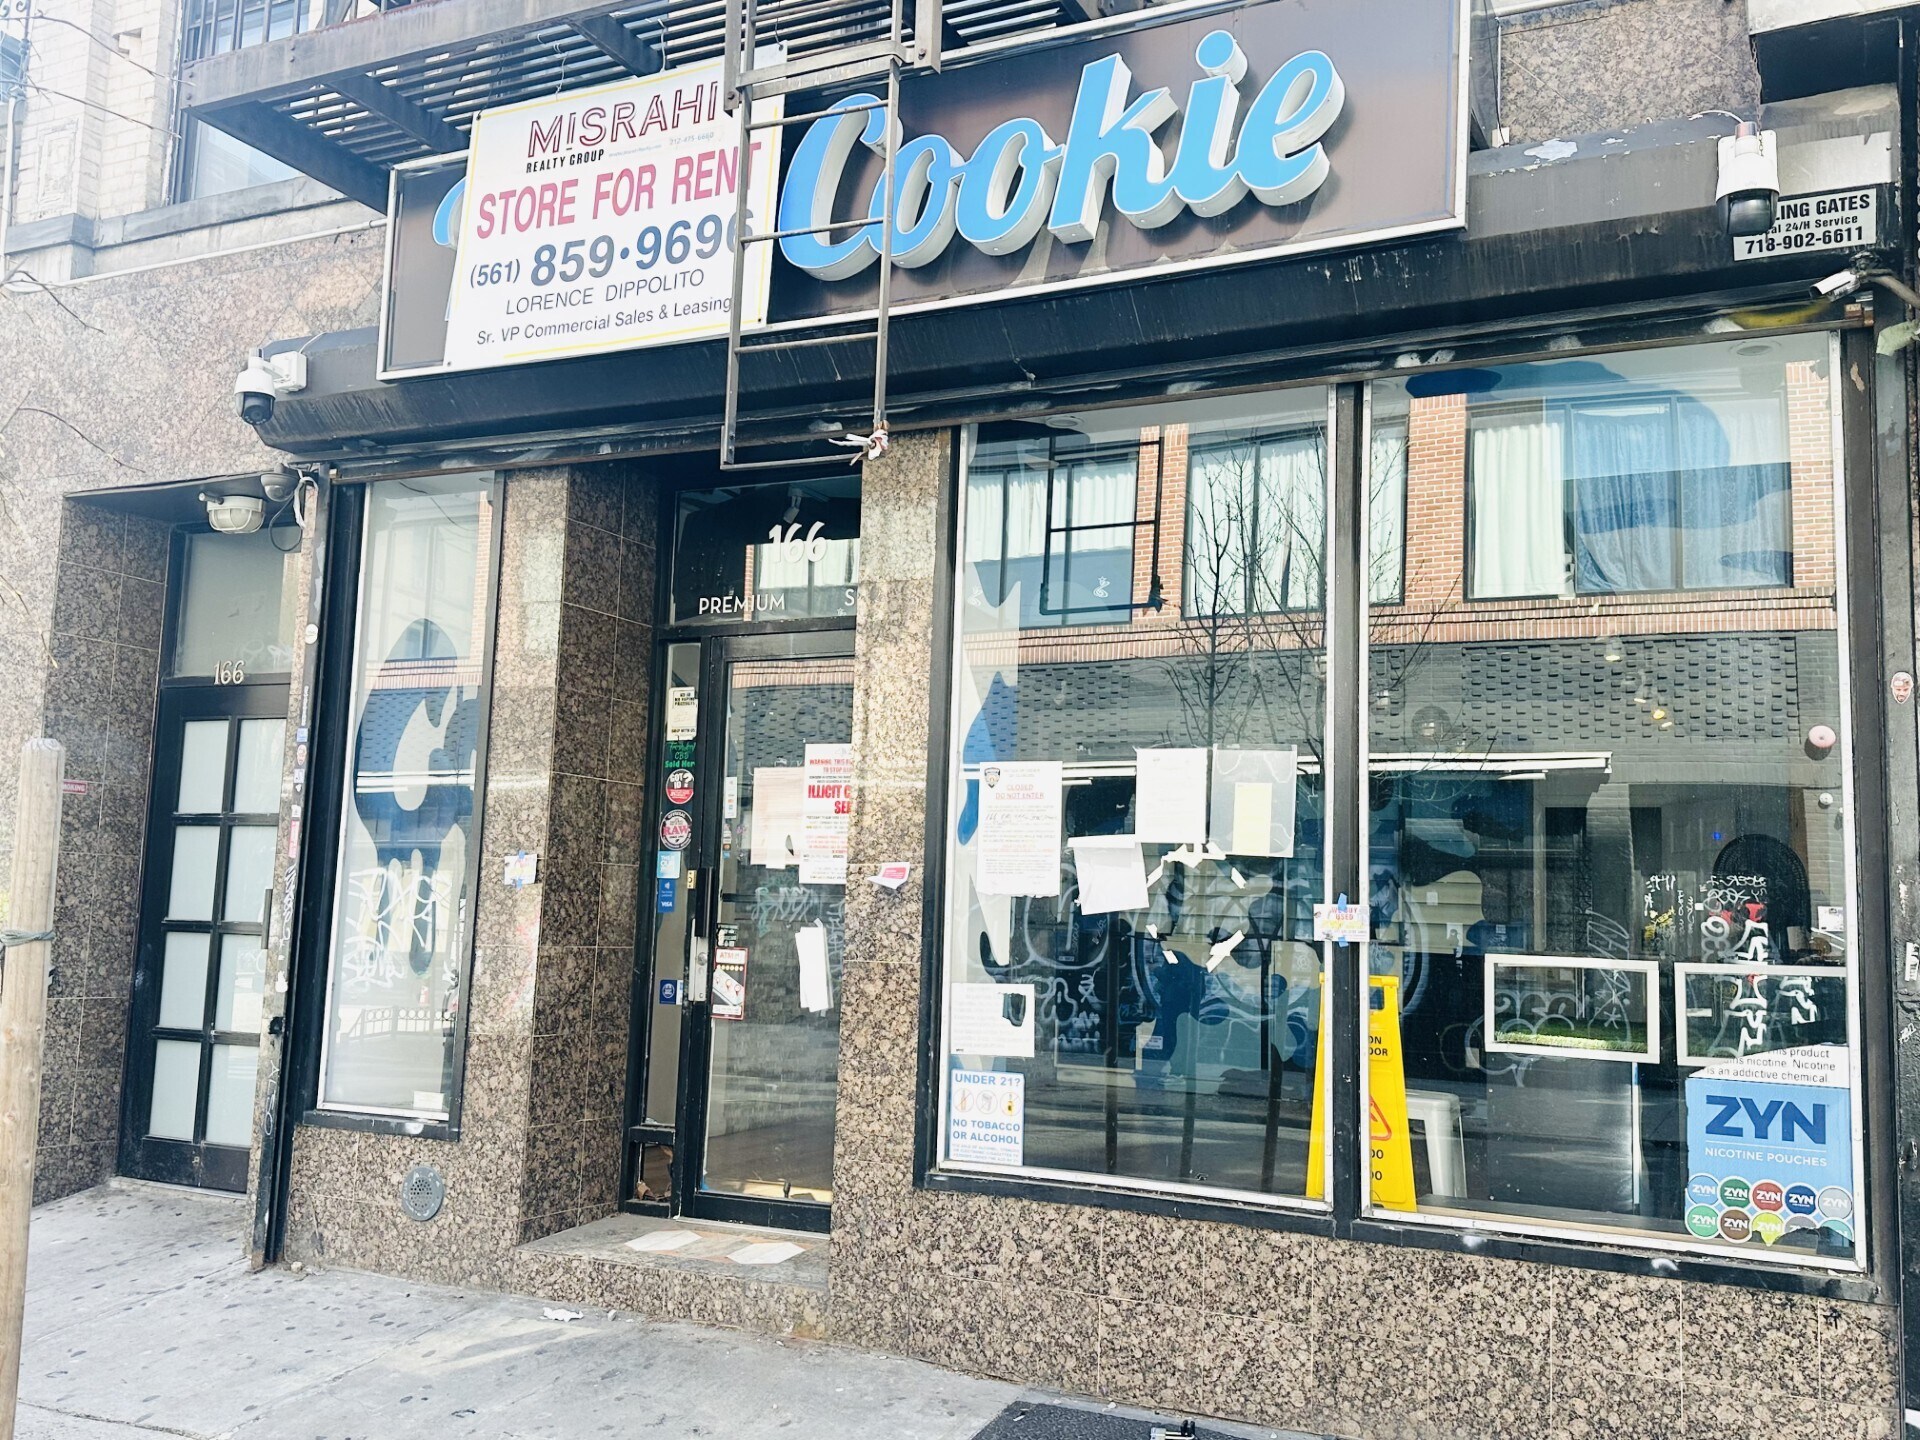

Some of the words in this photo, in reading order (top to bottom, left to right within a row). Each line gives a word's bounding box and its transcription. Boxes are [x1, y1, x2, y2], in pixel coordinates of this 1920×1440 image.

[527, 81, 718, 158] MISRAHI
[526, 157, 565, 173] REALTY
[569, 149, 605, 166] GROUP
[778, 30, 1344, 281] Cookie
[477, 178, 579, 239] STORE
[592, 164, 657, 219] FOR
[671, 142, 761, 205] RENT
[1776, 202, 1810, 220] ING
[1816, 194, 1870, 215] GATES
[1785, 221, 1811, 232] 24/H
[1815, 215, 1858, 228] Service
[1745, 226, 1863, 254] 718-902-6611
[470, 259, 520, 288] (561)
[506, 288, 594, 315] LORENCE
[605, 269, 704, 302] DIPPOLITO
[477, 331, 495, 345] Sr.
[501, 327, 520, 342] VP
[524, 315, 610, 338] Commercial
[615, 309, 654, 327] Sales
[659, 304, 668, 319] &
[673, 297, 732, 317] Leasing
[769, 521, 827, 563] 166
[699, 593, 785, 615] PREMIUM
[214, 660, 245, 685] 166
[669, 772, 684, 782] GOT
[673, 781, 682, 789] ID
[808, 785, 842, 798] ILLICIT
[1022, 792, 1045, 800] ENTER
[663, 825, 689, 835] RAW
[1790, 1048, 1830, 1058] product
[1793, 1060, 1836, 1071] Nicotine
[1706, 1067, 1715, 1075] is
[1733, 1067, 1778, 1079] addictive
[955, 1073, 996, 1085] UNDER
[1000, 1076, 1021, 1087] 21?
[952, 1119, 967, 1127] NO
[971, 1120, 1020, 1131] TOBACCO
[1706, 1095, 1826, 1144] ZYN
[953, 1131, 967, 1139] OR
[970, 1132, 1019, 1145] ALCOHOL
[1705, 1147, 1763, 1161] NICOTINE
[1767, 1152, 1827, 1167] POUCHES
[1692, 1184, 1716, 1195] ZYN
[1724, 1187, 1748, 1198] ZYN
[1756, 1190, 1782, 1202] ZYN
[1789, 1193, 1814, 1205] ZYN
[1822, 1197, 1848, 1209] ZYN
[1692, 1214, 1716, 1225] ZYN
[1724, 1217, 1749, 1229] ZYN
[1757, 1221, 1782, 1232] ZYN
